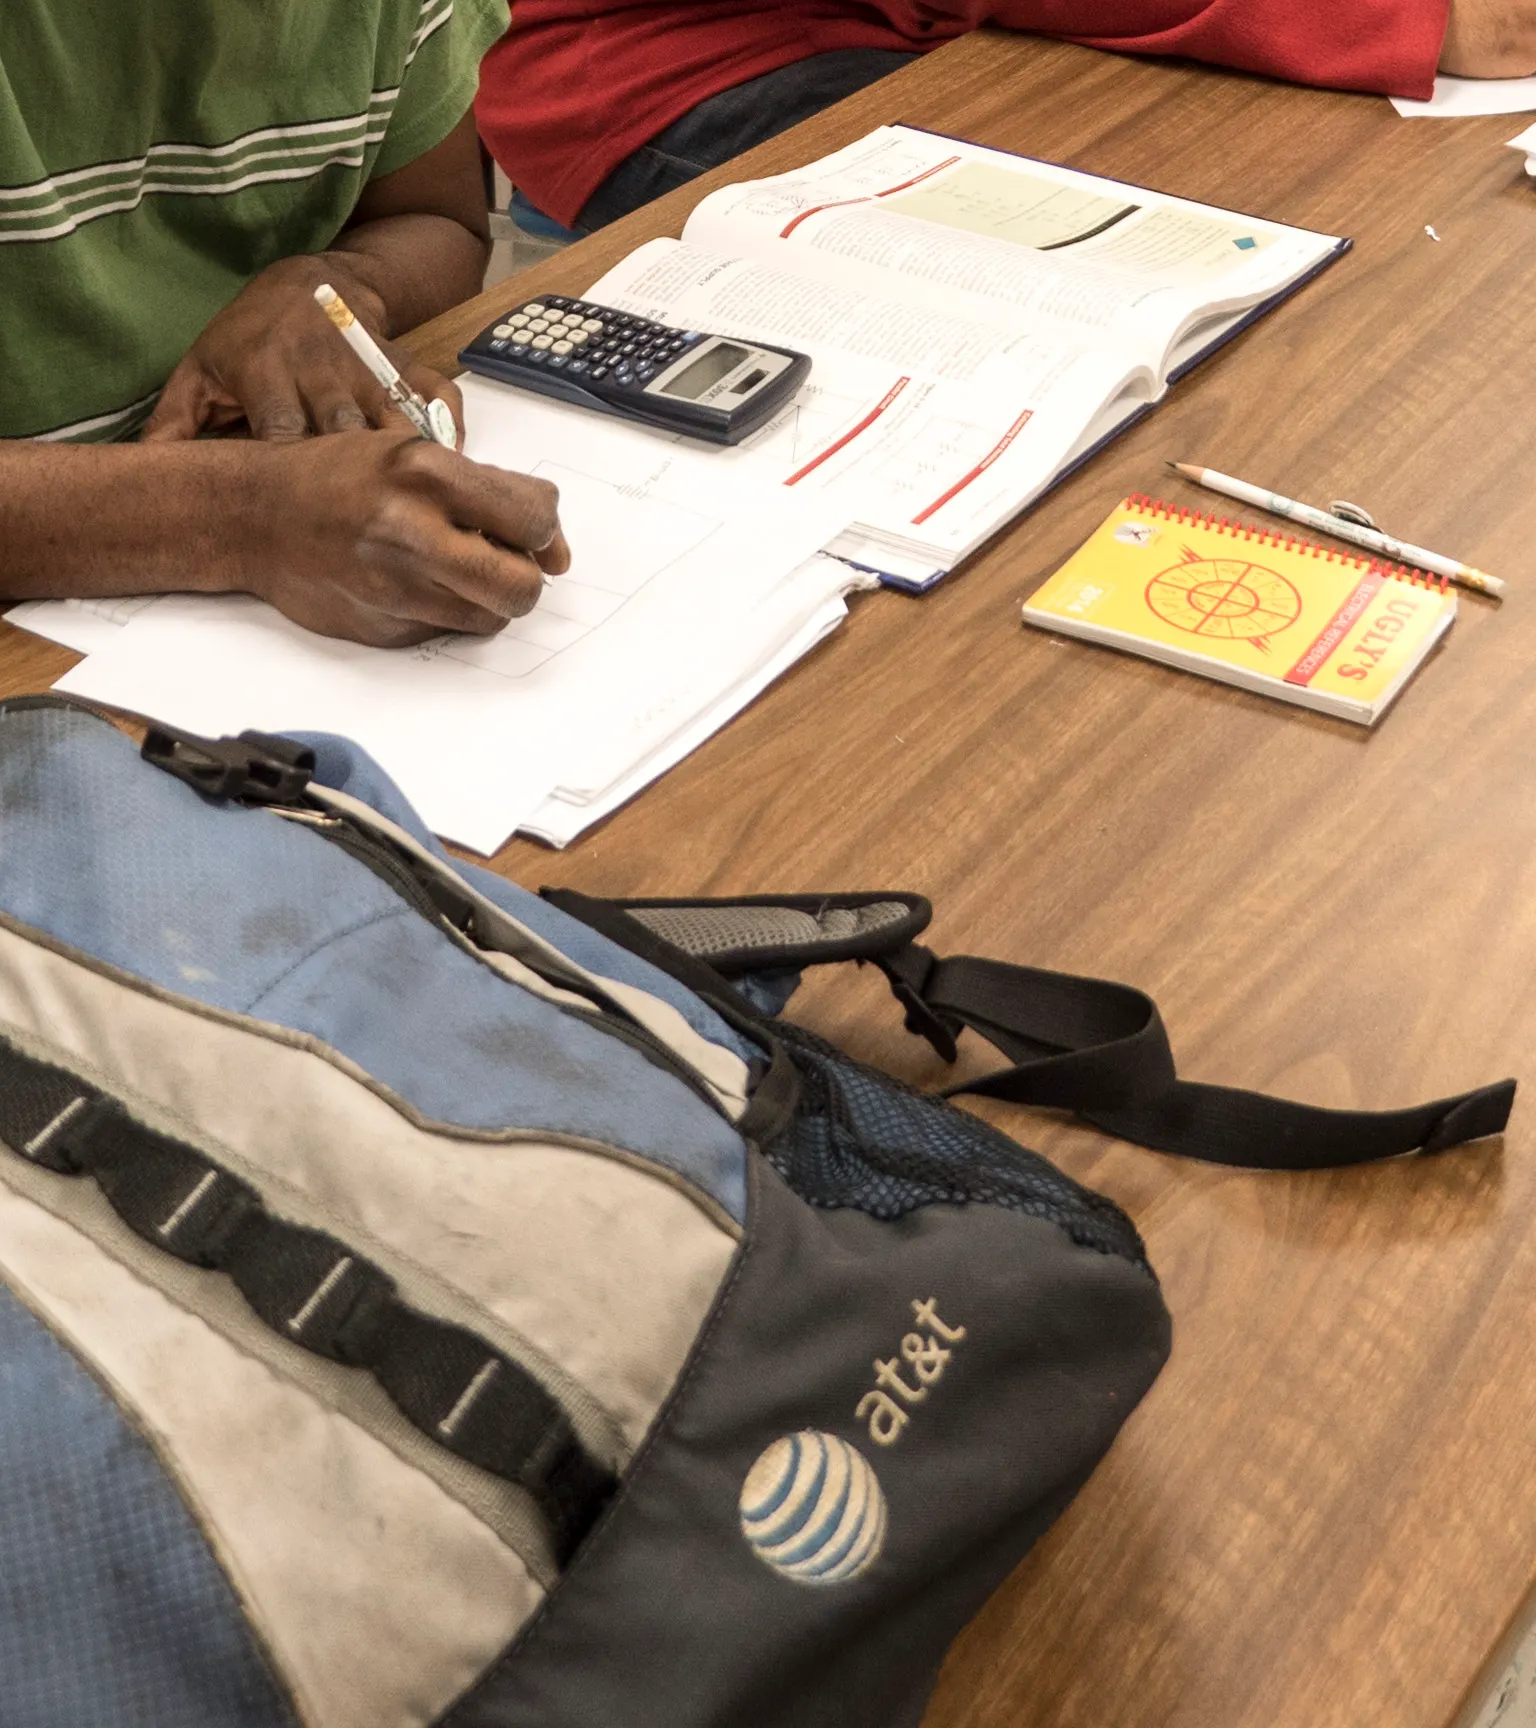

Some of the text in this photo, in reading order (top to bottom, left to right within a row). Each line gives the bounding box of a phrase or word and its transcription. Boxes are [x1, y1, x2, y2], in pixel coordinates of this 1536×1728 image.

[1295, 583, 1375, 675] ELECTRICAL REFERENCES
[1336, 598, 1420, 681] UGLY'S
[854, 1296, 968, 1448] at&t
